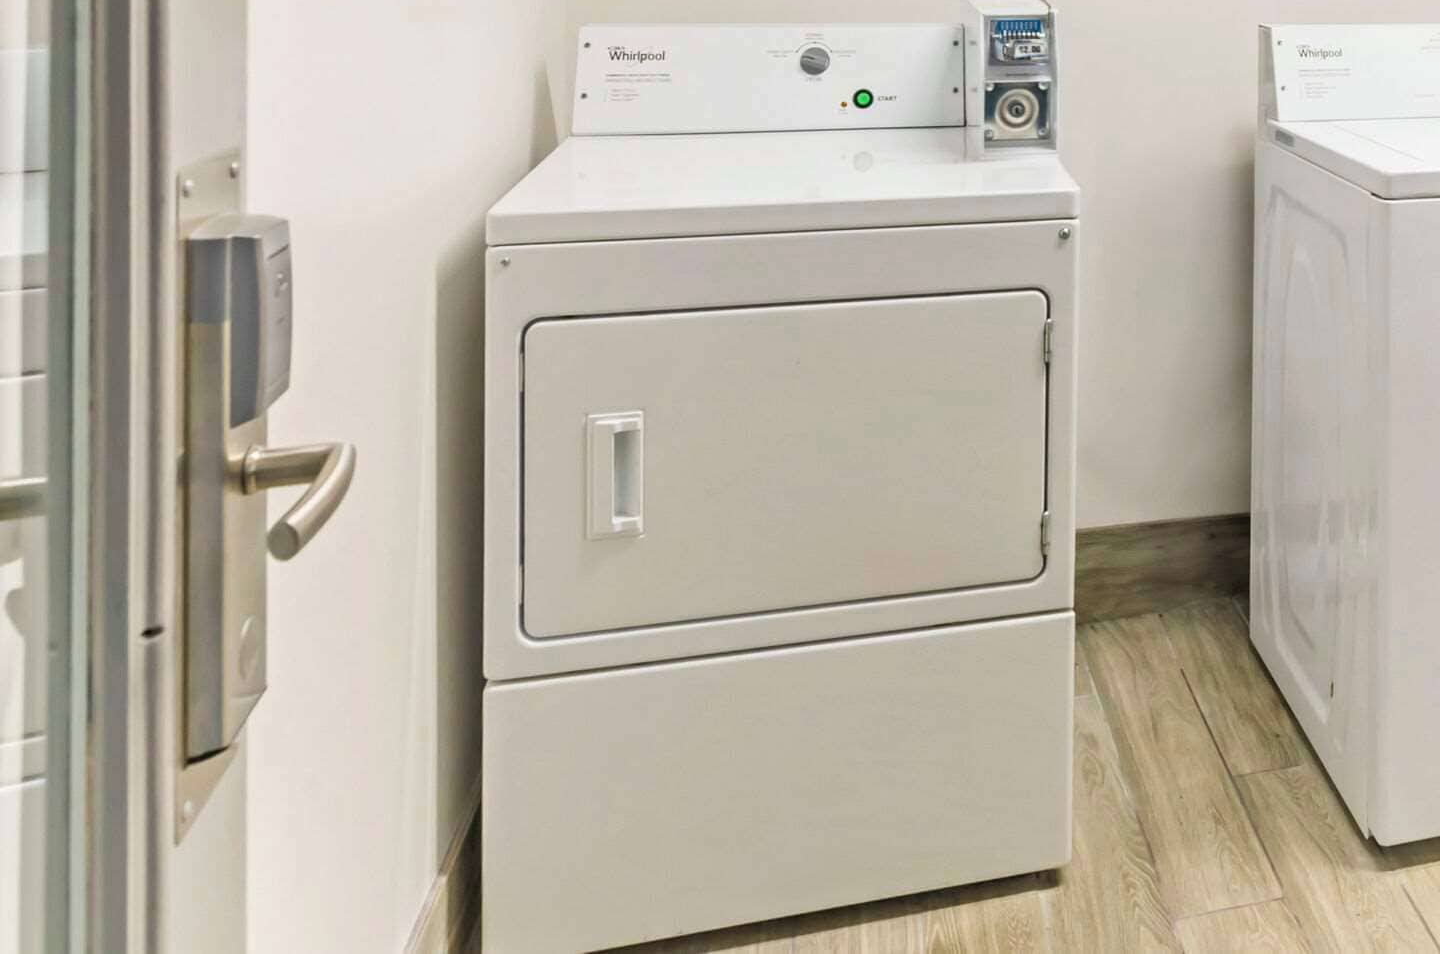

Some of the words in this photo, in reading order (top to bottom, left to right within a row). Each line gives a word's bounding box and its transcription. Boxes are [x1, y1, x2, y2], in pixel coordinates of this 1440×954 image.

[608, 49, 666, 64] Whirlpool
[1298, 47, 1343, 60] Whirlpool
[877, 94, 898, 102] START
